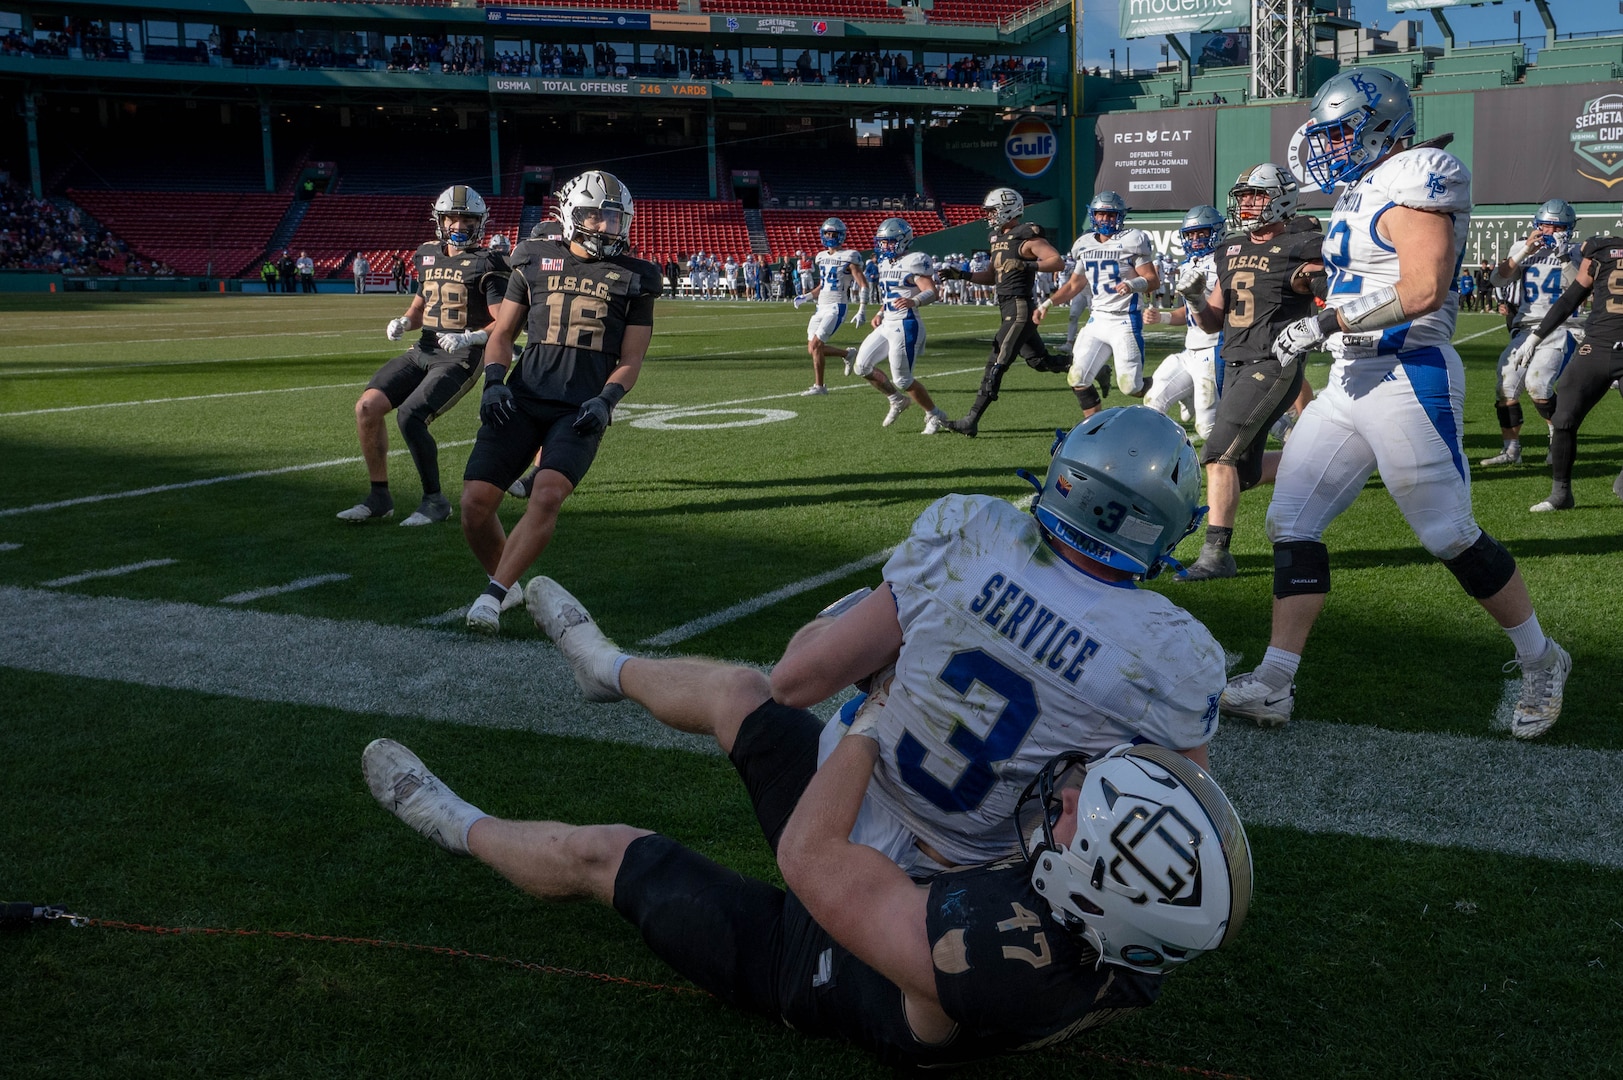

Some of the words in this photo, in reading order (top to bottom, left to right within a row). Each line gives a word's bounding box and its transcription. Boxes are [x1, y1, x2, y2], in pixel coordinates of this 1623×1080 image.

[770, 26, 785, 34] CUP
[497, 81, 531, 91] USMMA
[542, 81, 577, 92] TOTAL
[580, 82, 629, 94] OFFENSE
[639, 85, 661, 95] 246
[671, 85, 707, 96] YARDS
[1114, 132, 1143, 144] RED
[1160, 130, 1192, 141] CAT
[1599, 127, 1623, 141] CUP
[1006, 135, 1053, 157] Gulf
[1115, 160, 1137, 168] FUTURE
[1147, 158, 1188, 166] ALL-DOMAIN
[1130, 167, 1171, 175] OPERATIONS
[1485, 230, 1491, 240] 2
[1503, 230, 1509, 240] 3
[1490, 241, 1497, 250] 6
[1227, 255, 1270, 273] U.S.C.G.
[1323, 218, 1364, 294] 2
[1472, 252, 1478, 261] 7
[425, 267, 464, 283] U.S.C.G.
[1086, 260, 1122, 295] 73
[547, 275, 611, 301] U.S.C.G.
[1523, 267, 1563, 304] 64
[422, 281, 468, 329] 28
[541, 292, 608, 352] 16
[1096, 500, 1128, 534] 3
[968, 571, 1103, 686] SERVICE
[896, 646, 1042, 815] 3
[996, 901, 1052, 969] 47
